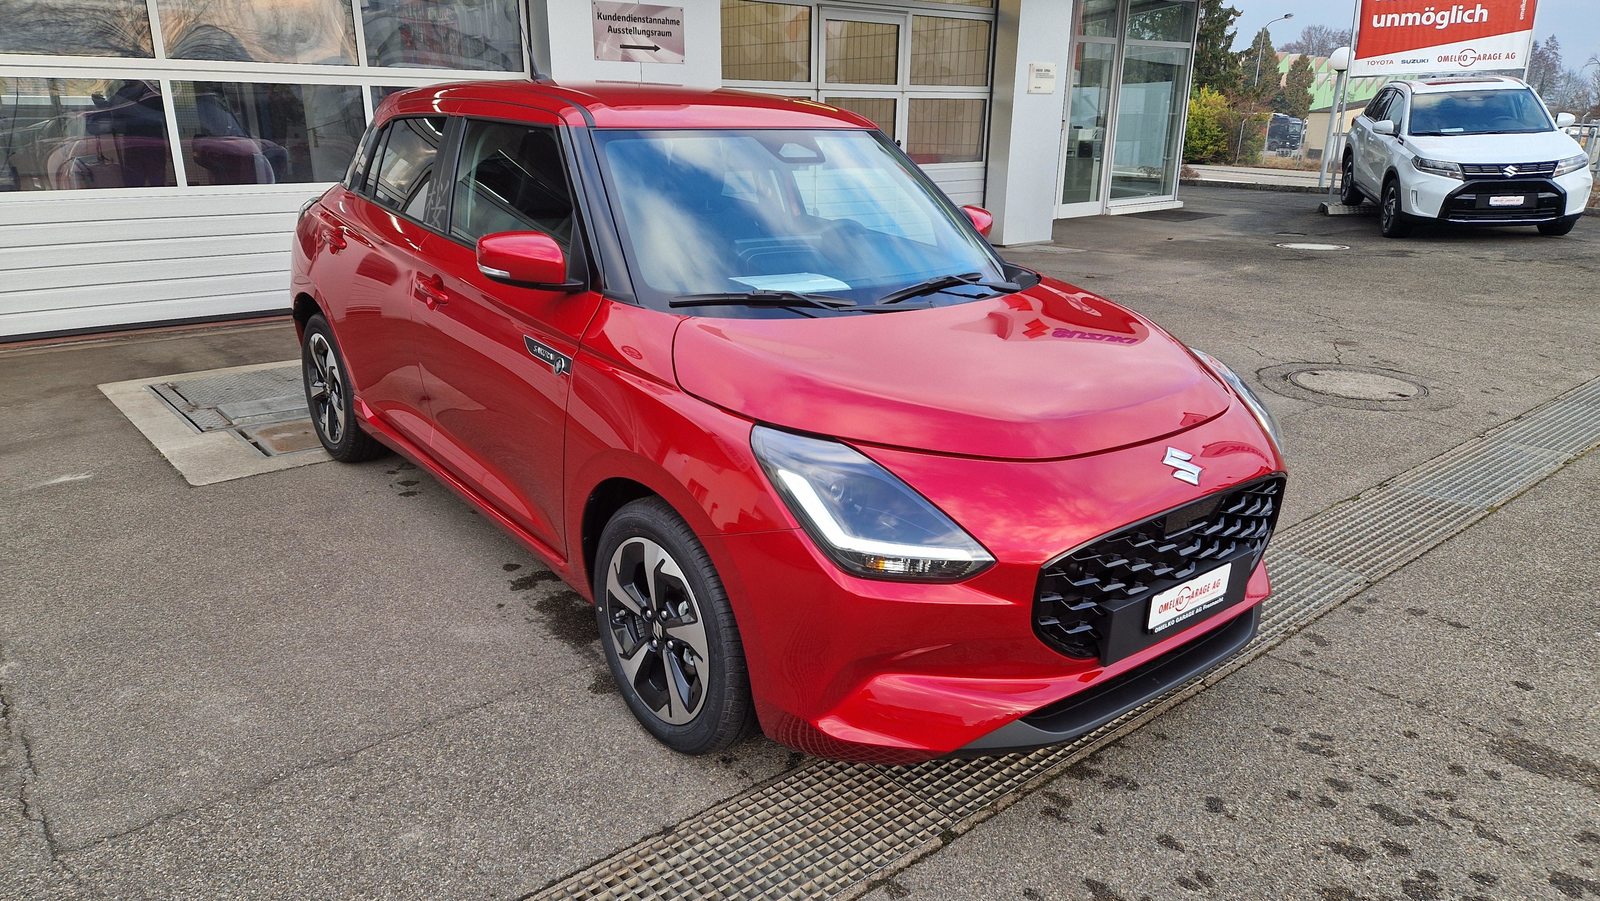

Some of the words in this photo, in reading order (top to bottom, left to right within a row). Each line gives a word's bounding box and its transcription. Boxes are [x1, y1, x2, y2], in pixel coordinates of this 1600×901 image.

[596, 11, 681, 26] Kundendienstannahme
[1372, 4, 1488, 29] unmöglich
[607, 25, 672, 38] Ausstellungsraum
[1437, 54, 1467, 63] OMELKO
[1458, 48, 1502, 67] GARAGE
[1505, 52, 1516, 60] AG
[1158, 596, 1183, 614] OMELKO
[1211, 578, 1222, 590] AG
[1154, 619, 1176, 633] OMELKO
[1175, 609, 1195, 624] GARAGE
[1195, 605, 1203, 614] AG
